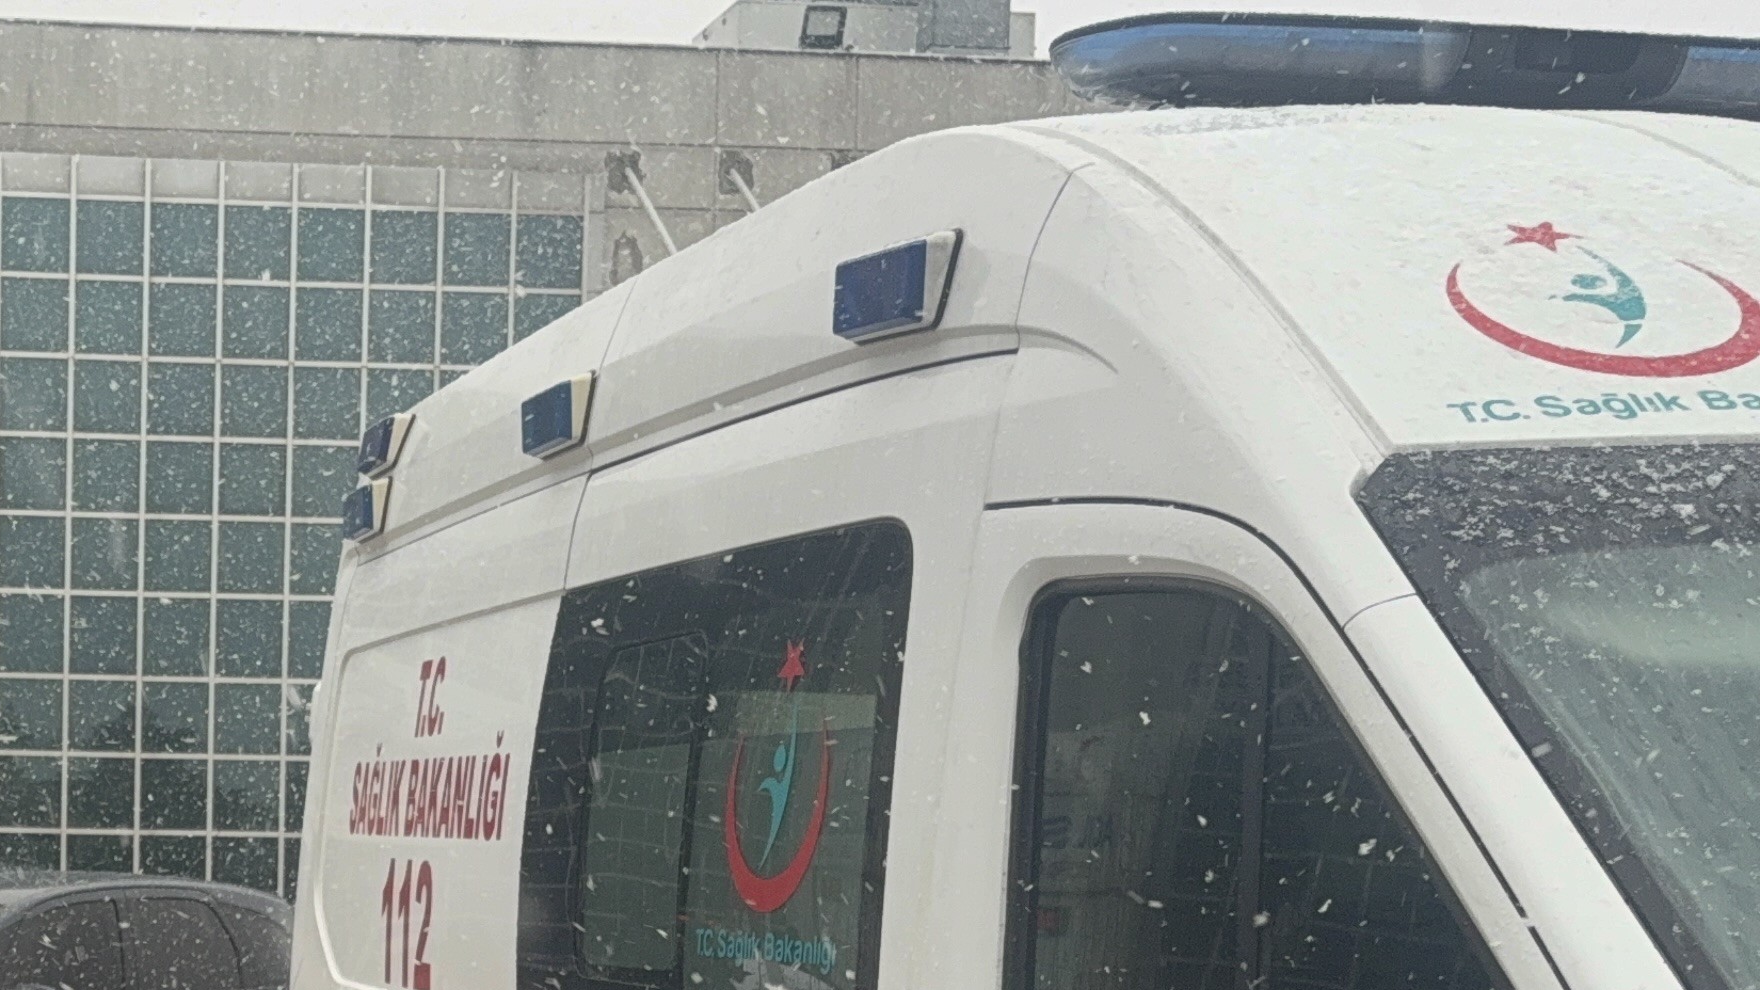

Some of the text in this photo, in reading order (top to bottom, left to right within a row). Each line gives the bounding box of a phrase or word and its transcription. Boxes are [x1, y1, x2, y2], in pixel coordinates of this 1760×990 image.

[1446, 398, 1531, 423] T.C.
[1533, 391, 1691, 420] Sağlık
[414, 655, 447, 738] T.C.
[349, 729, 511, 841] SAĞLIK BAKANLIĞI
